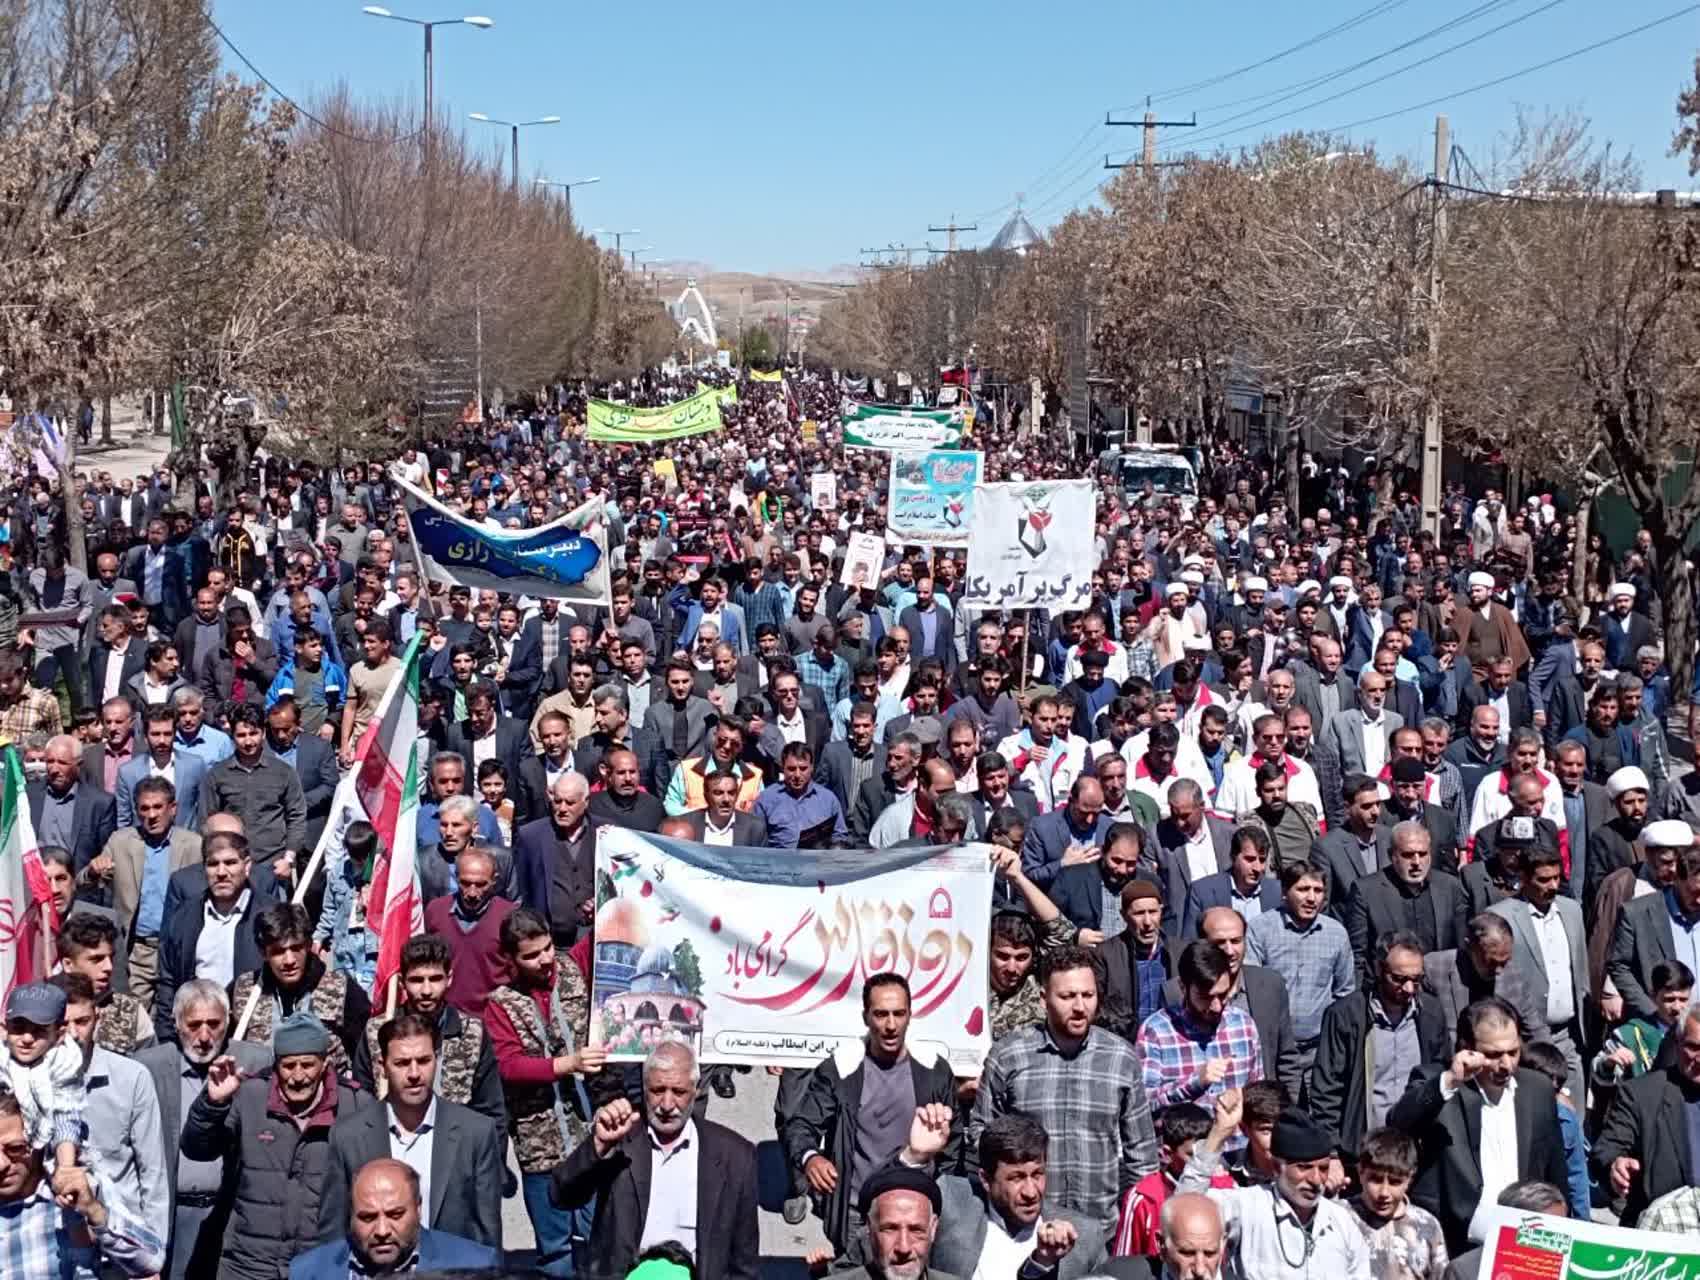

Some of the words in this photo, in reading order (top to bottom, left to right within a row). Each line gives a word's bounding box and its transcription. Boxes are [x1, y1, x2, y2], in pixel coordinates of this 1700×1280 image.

[674, 400, 712, 423] دبستان
[966, 570, 1029, 606] آمریکا
[1023, 580, 1047, 605] بر
[1049, 572, 1092, 605] مرگ
[743, 906, 817, 978] گرامی
[724, 939, 744, 990] باد
[808, 1040, 825, 1053] ابن
